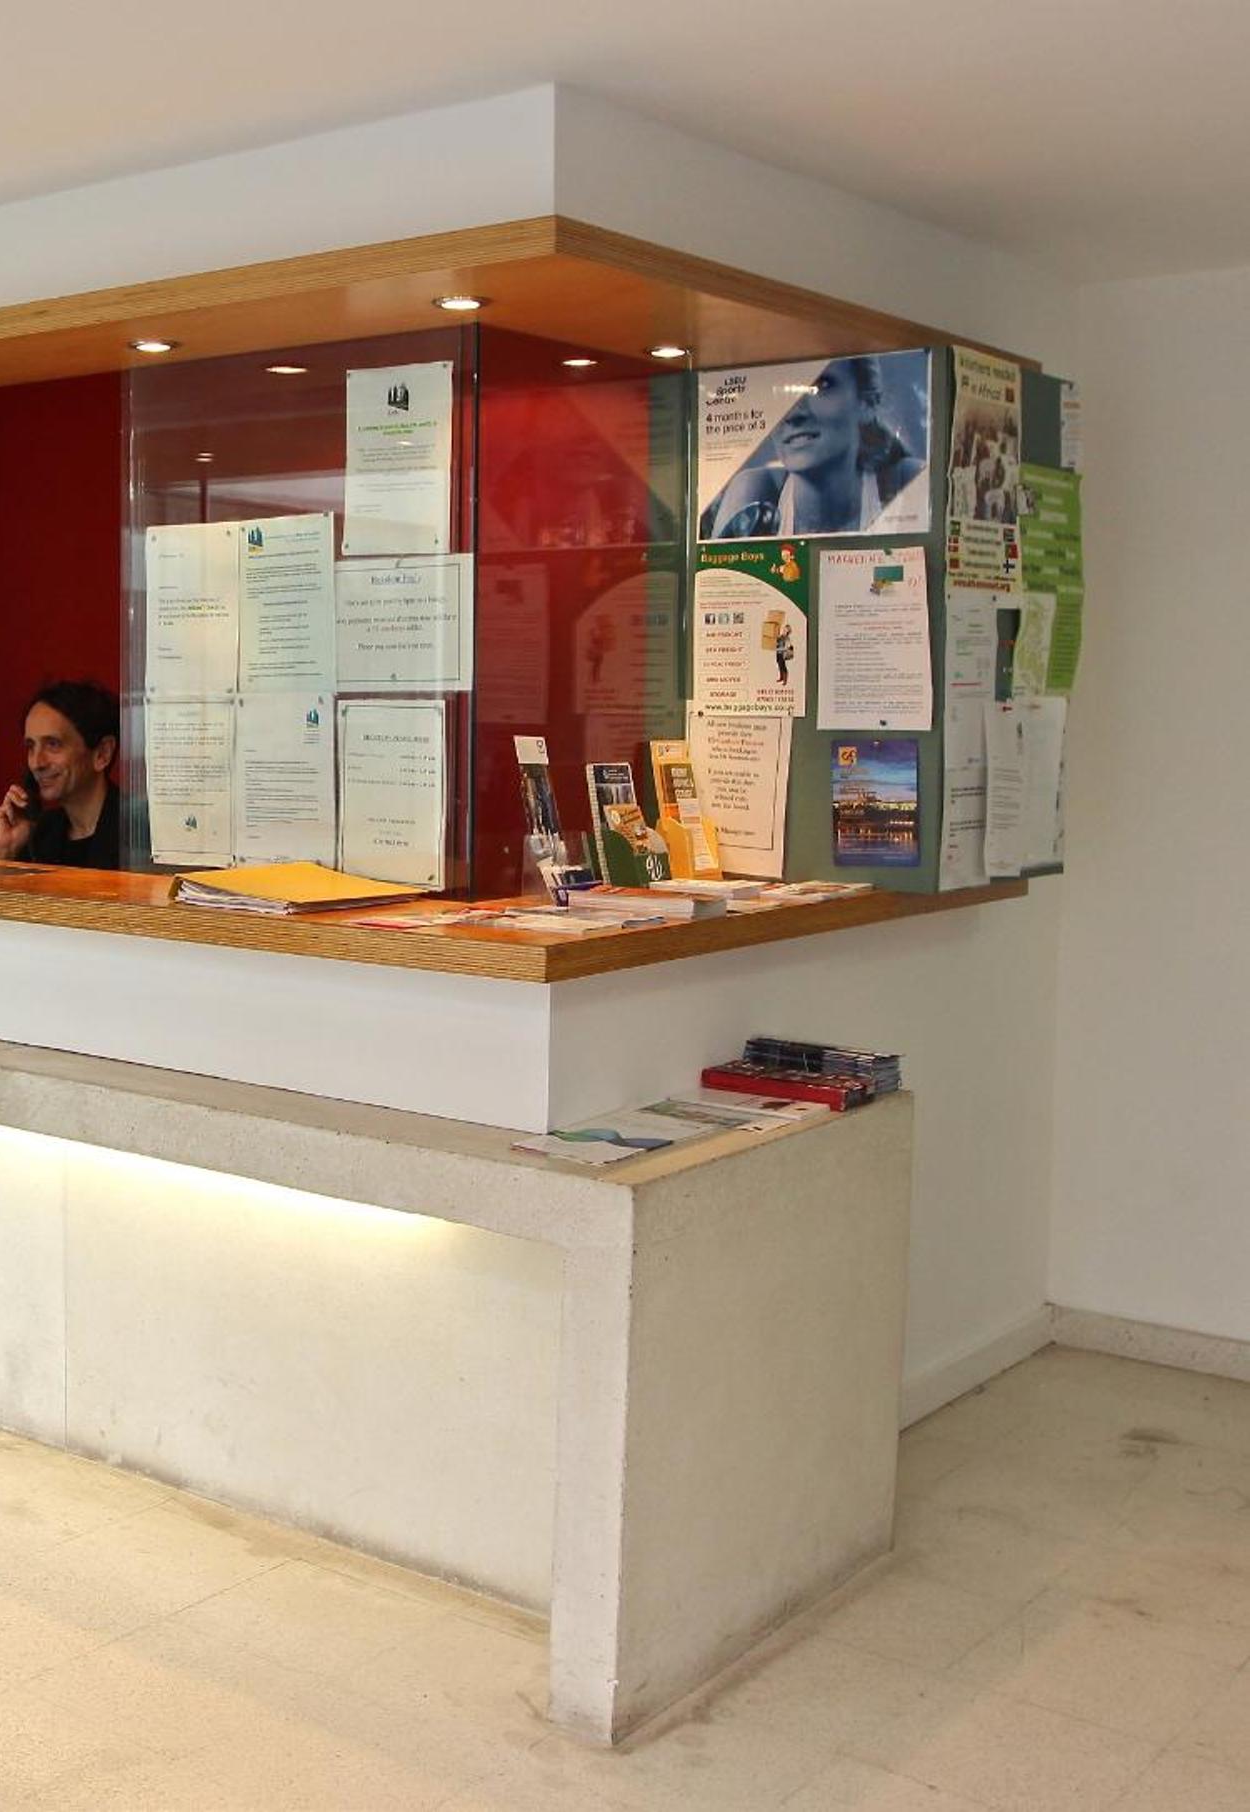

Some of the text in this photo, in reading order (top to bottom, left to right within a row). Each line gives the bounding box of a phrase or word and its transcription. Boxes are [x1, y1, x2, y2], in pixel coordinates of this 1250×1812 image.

[706, 409, 764, 423] 4 months for
[705, 420, 766, 435] the price of 3
[701, 551, 765, 565] Baggage Boys
